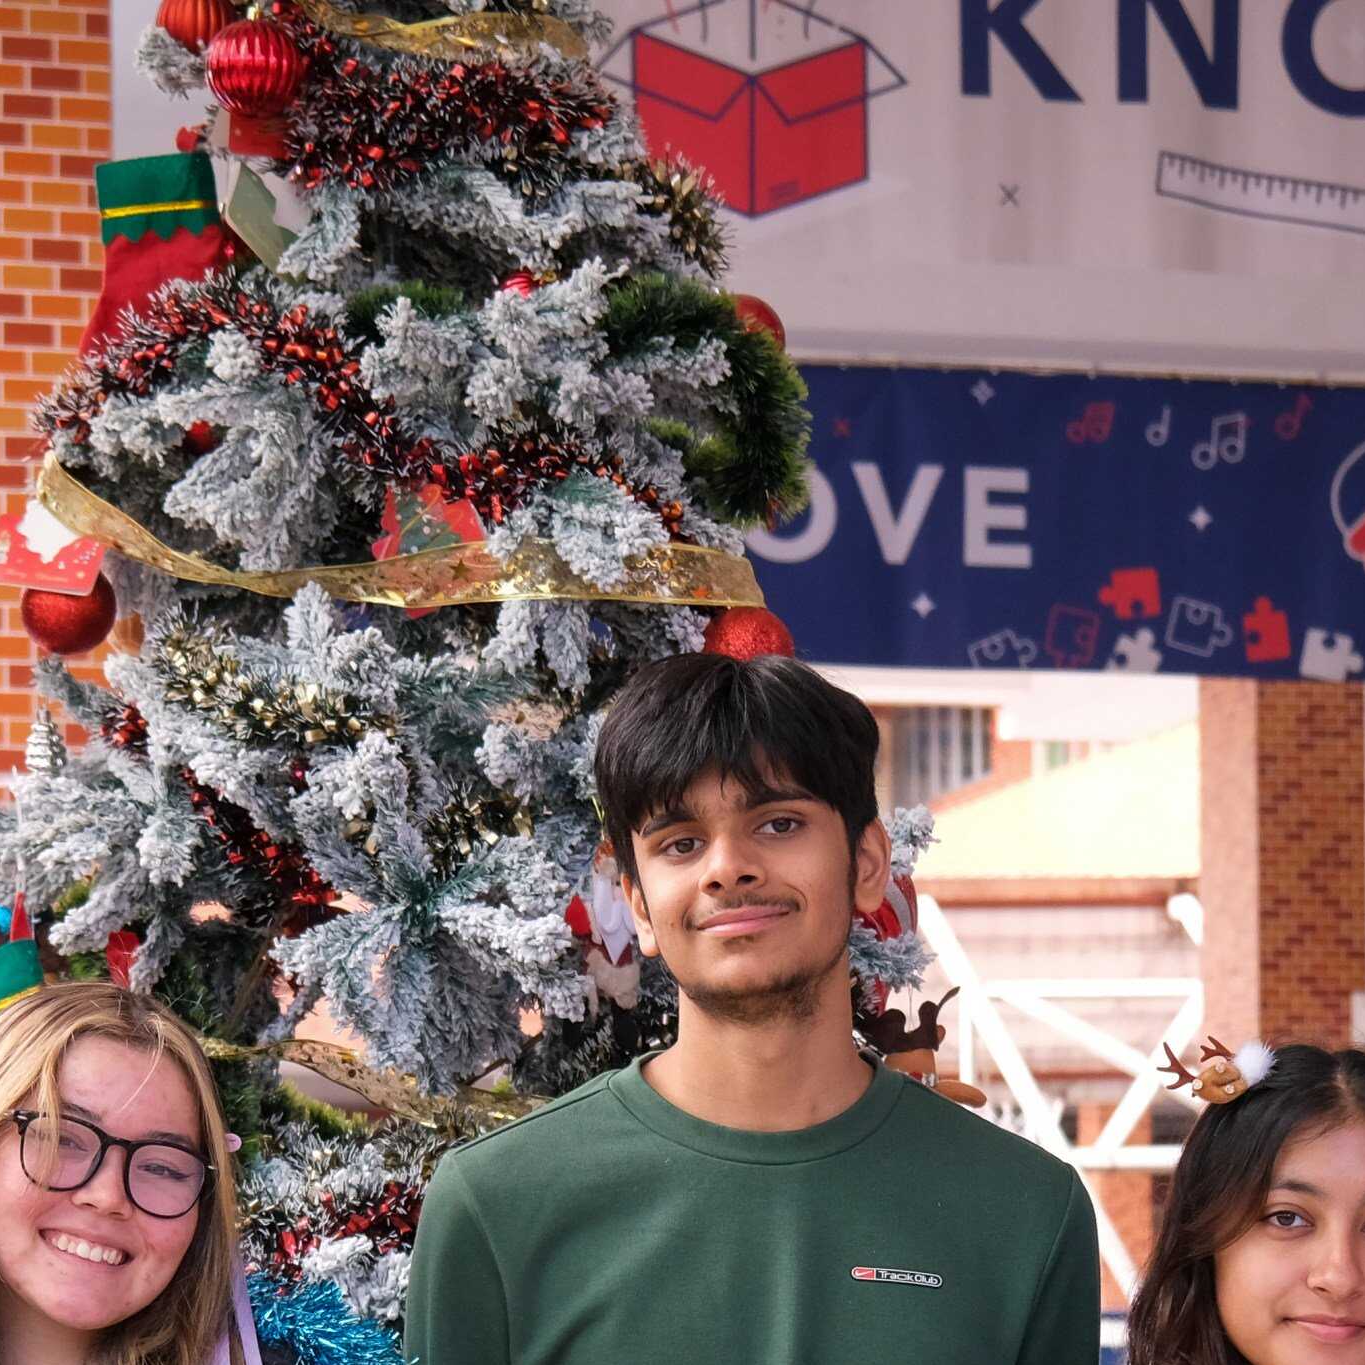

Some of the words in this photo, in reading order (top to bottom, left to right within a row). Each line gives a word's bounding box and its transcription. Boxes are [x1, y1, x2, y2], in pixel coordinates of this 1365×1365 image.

[743, 462, 1033, 569] OVE
[878, 1270, 914, 1281] Track
[915, 1274, 939, 1284] Club
